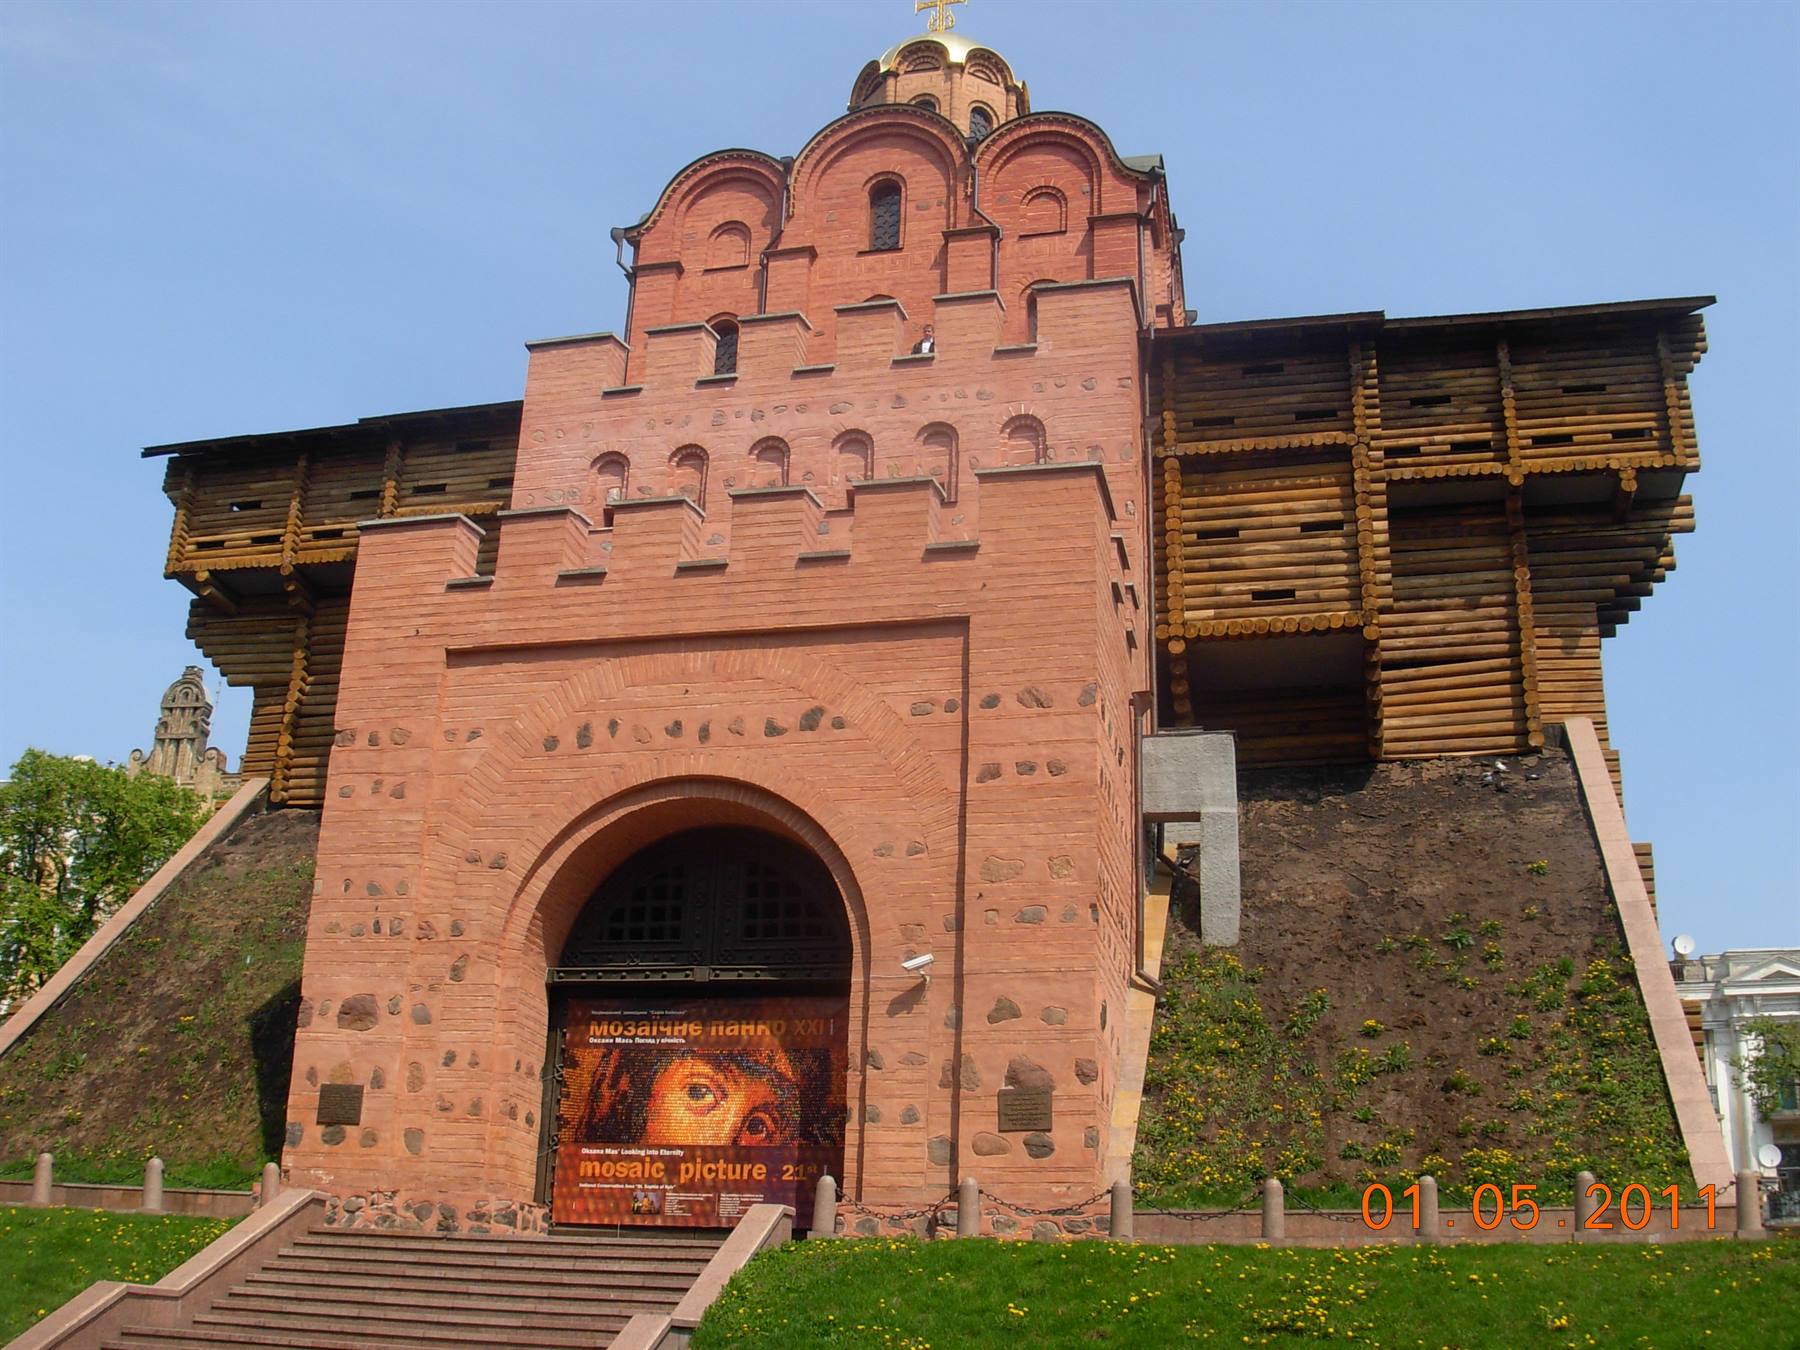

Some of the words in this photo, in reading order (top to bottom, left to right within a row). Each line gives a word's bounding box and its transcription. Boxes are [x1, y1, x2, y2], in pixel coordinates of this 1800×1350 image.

[589, 1015, 703, 1036] мозаїчне
[710, 1020, 786, 1036] панно
[620, 1148, 646, 1156] Looking
[660, 1149, 684, 1157] Eternity
[579, 1156, 665, 1178] mosaic
[679, 1157, 768, 1184] picture
